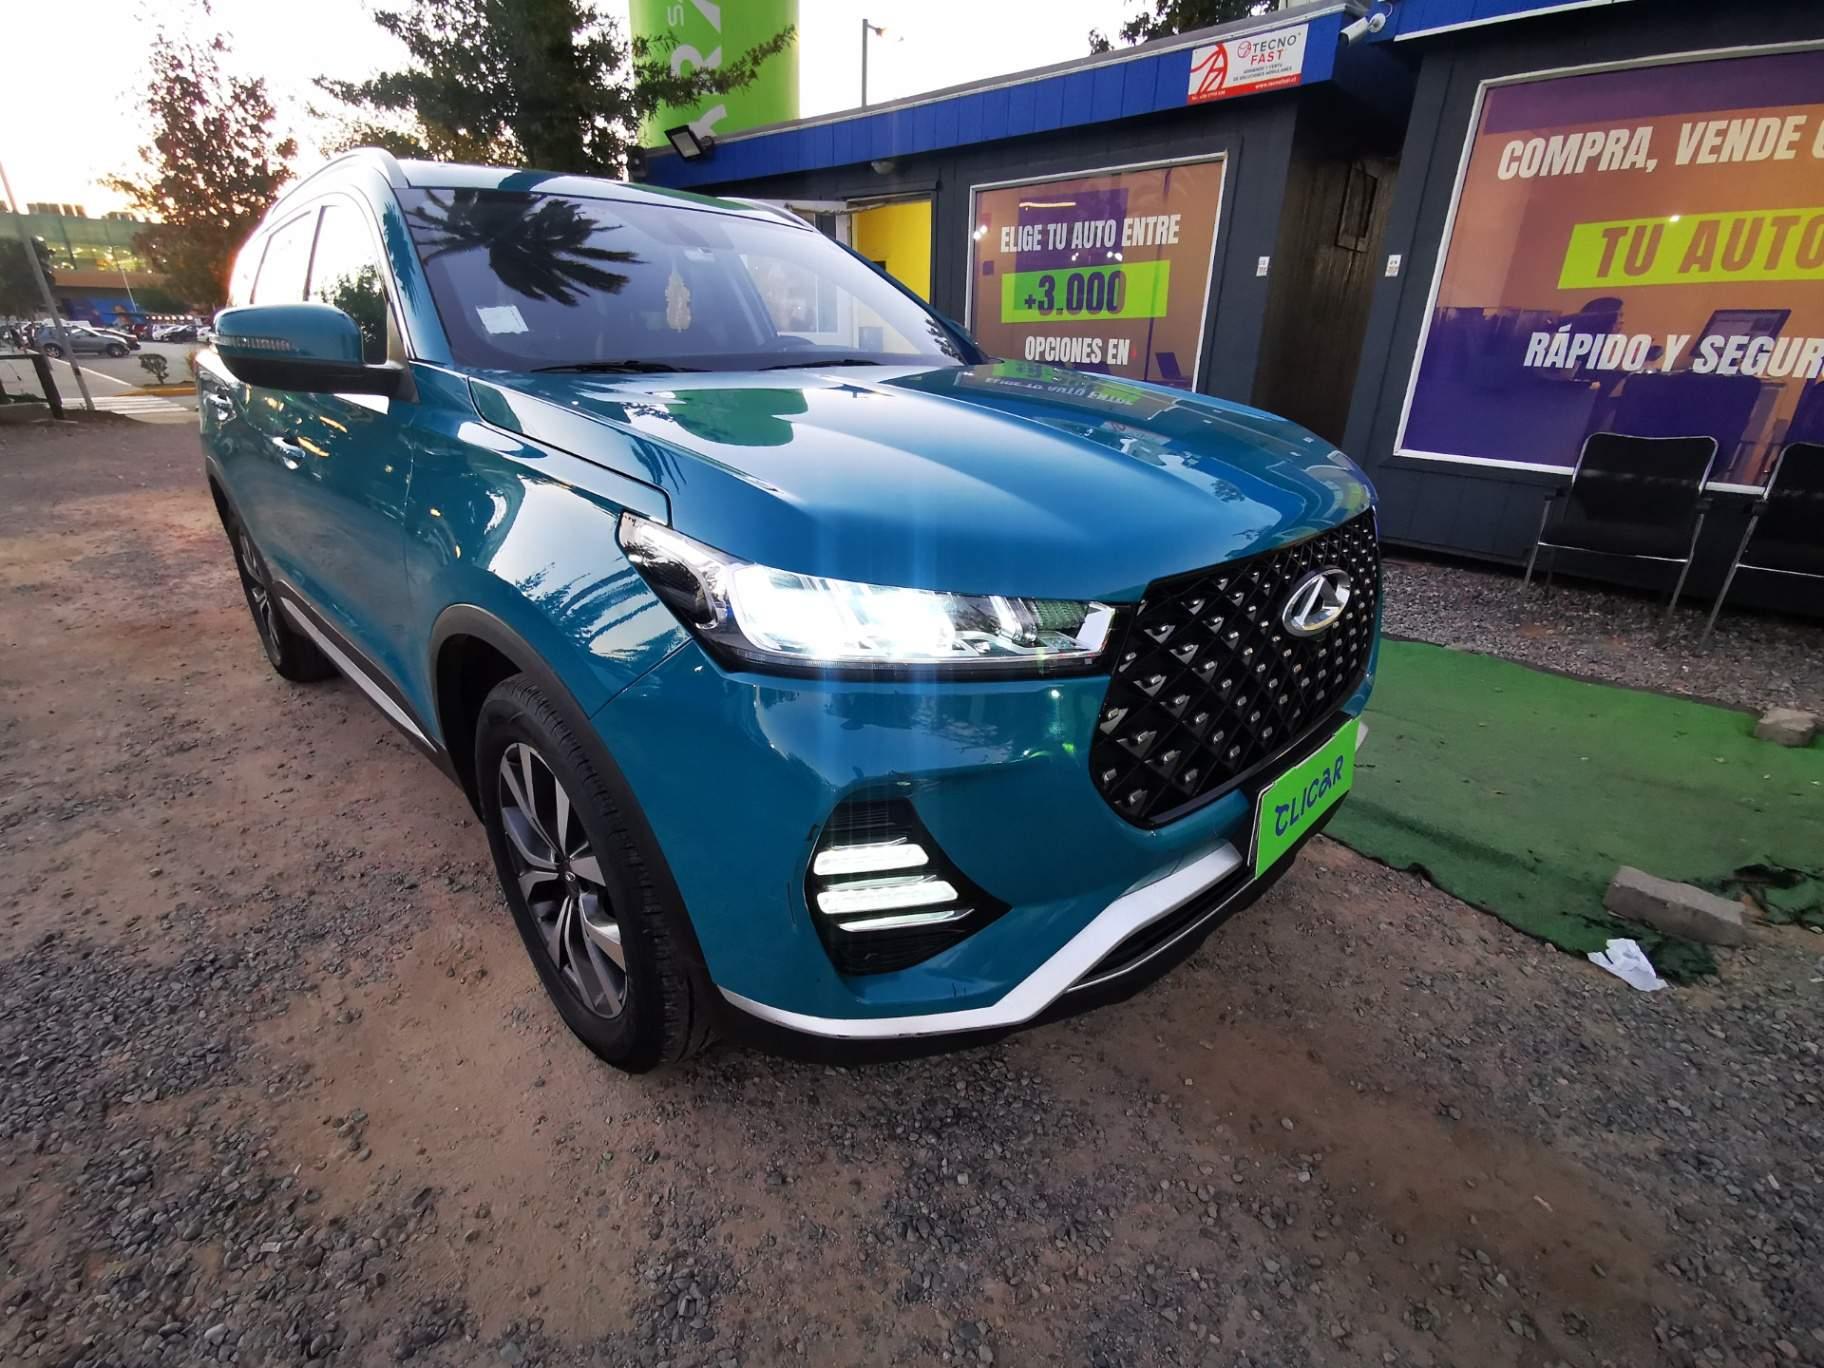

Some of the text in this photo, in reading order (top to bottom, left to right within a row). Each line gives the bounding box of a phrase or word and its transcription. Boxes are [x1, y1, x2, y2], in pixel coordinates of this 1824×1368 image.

[1250, 49, 1284, 66] FAST
[1253, 35, 1297, 53] TECNO
[1497, 126, 1658, 180] COMPRA,
[1675, 115, 1807, 166] VENDE
[1000, 214, 1182, 253] ELIGE TU AUTO ENTRE
[1596, 224, 1665, 279] TU
[1024, 271, 1126, 315] +3.000
[1024, 335, 1130, 366] OPCIONES EN
[1523, 323, 1824, 379] RÁPIDO Y SEGUR
